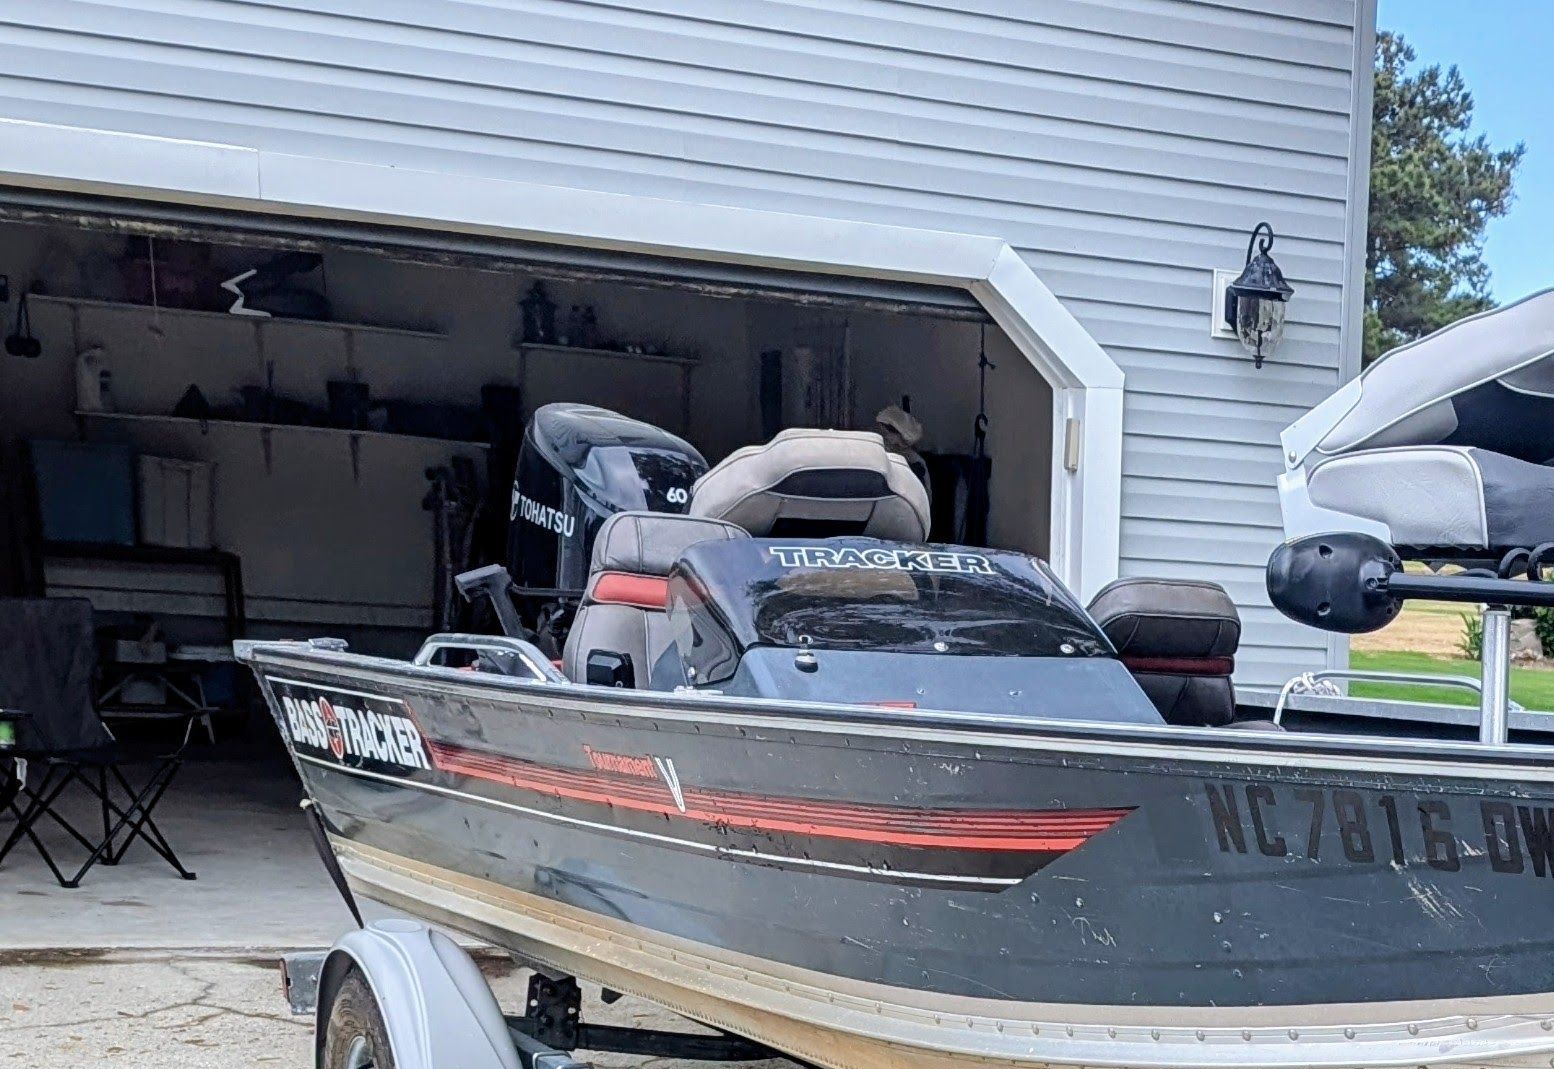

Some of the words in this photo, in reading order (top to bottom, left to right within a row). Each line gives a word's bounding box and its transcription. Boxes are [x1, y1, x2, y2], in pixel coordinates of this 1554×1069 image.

[520, 495, 575, 537] TOHATSU
[666, 487, 688, 504] 60
[769, 546, 998, 574] TRACKER
[282, 696, 329, 749] BASS
[332, 704, 432, 770] TRACKER
[1205, 783, 1287, 857] NC
[1294, 788, 1461, 873] 7816
